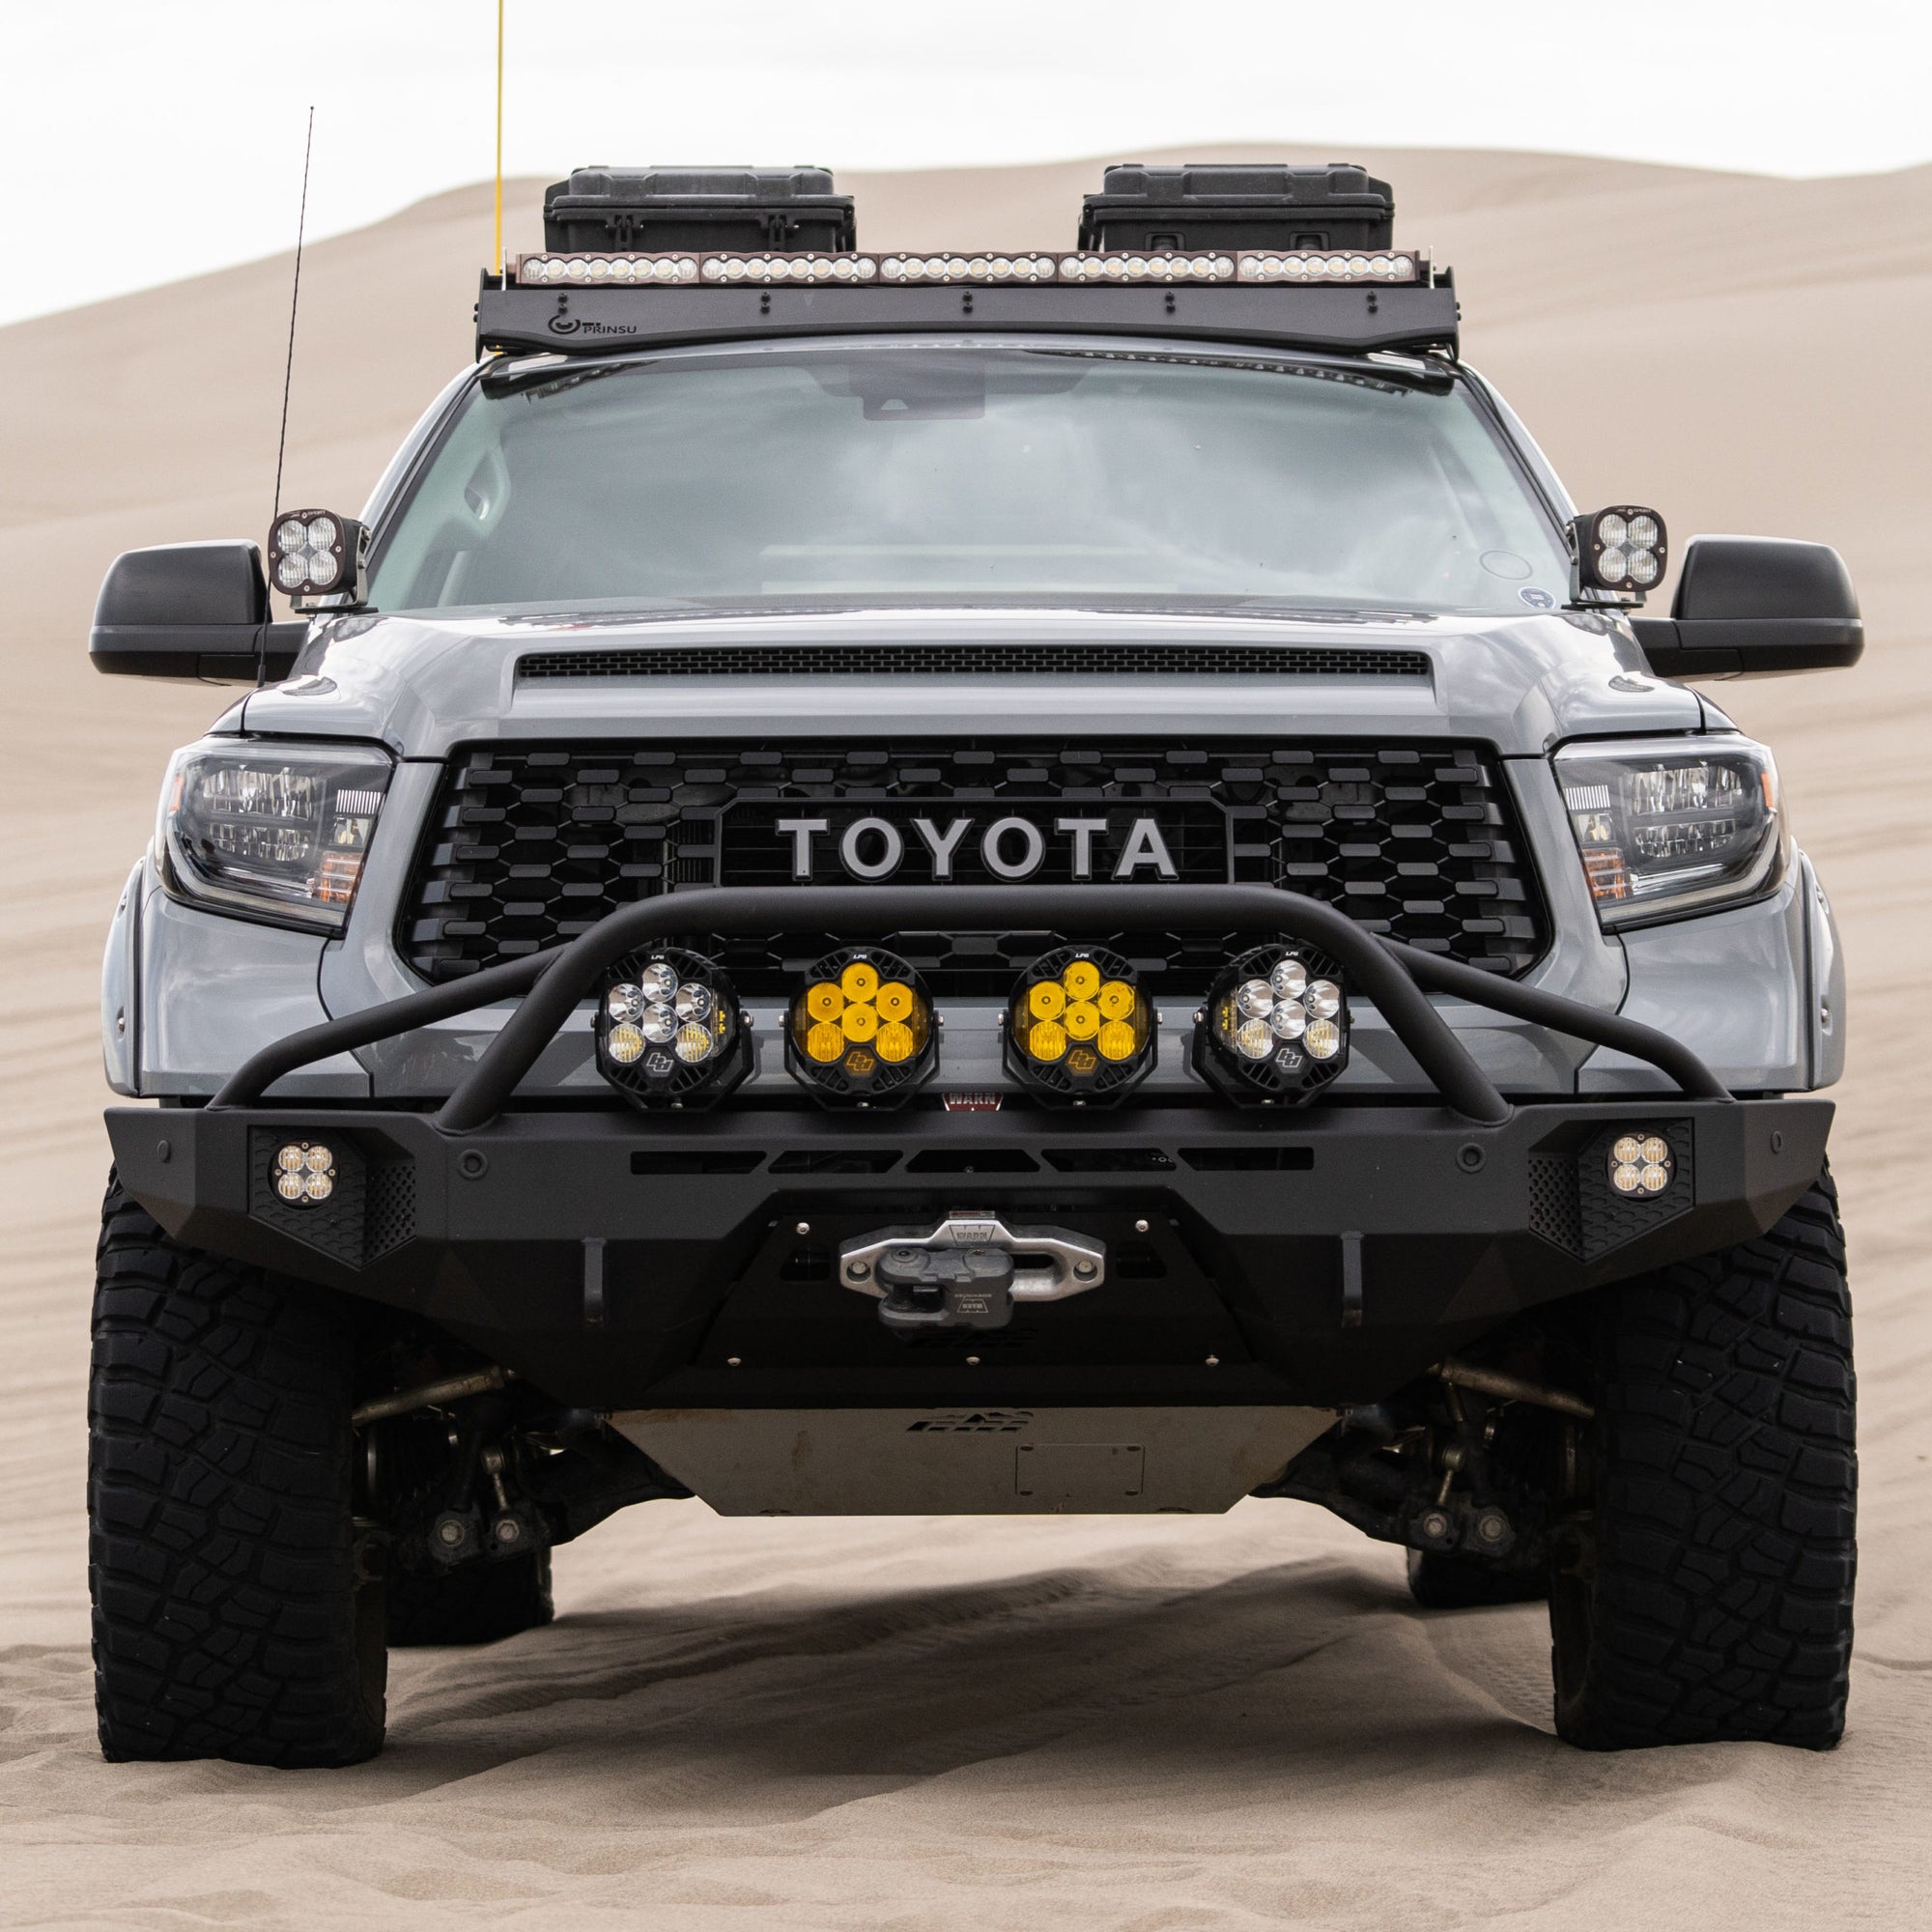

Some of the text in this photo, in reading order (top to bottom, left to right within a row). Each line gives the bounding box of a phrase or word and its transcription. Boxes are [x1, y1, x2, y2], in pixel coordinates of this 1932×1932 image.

[583, 326, 637, 334] PRINSU
[776, 817, 1179, 881] TOYOTA
[950, 1093, 996, 1105] WARN
